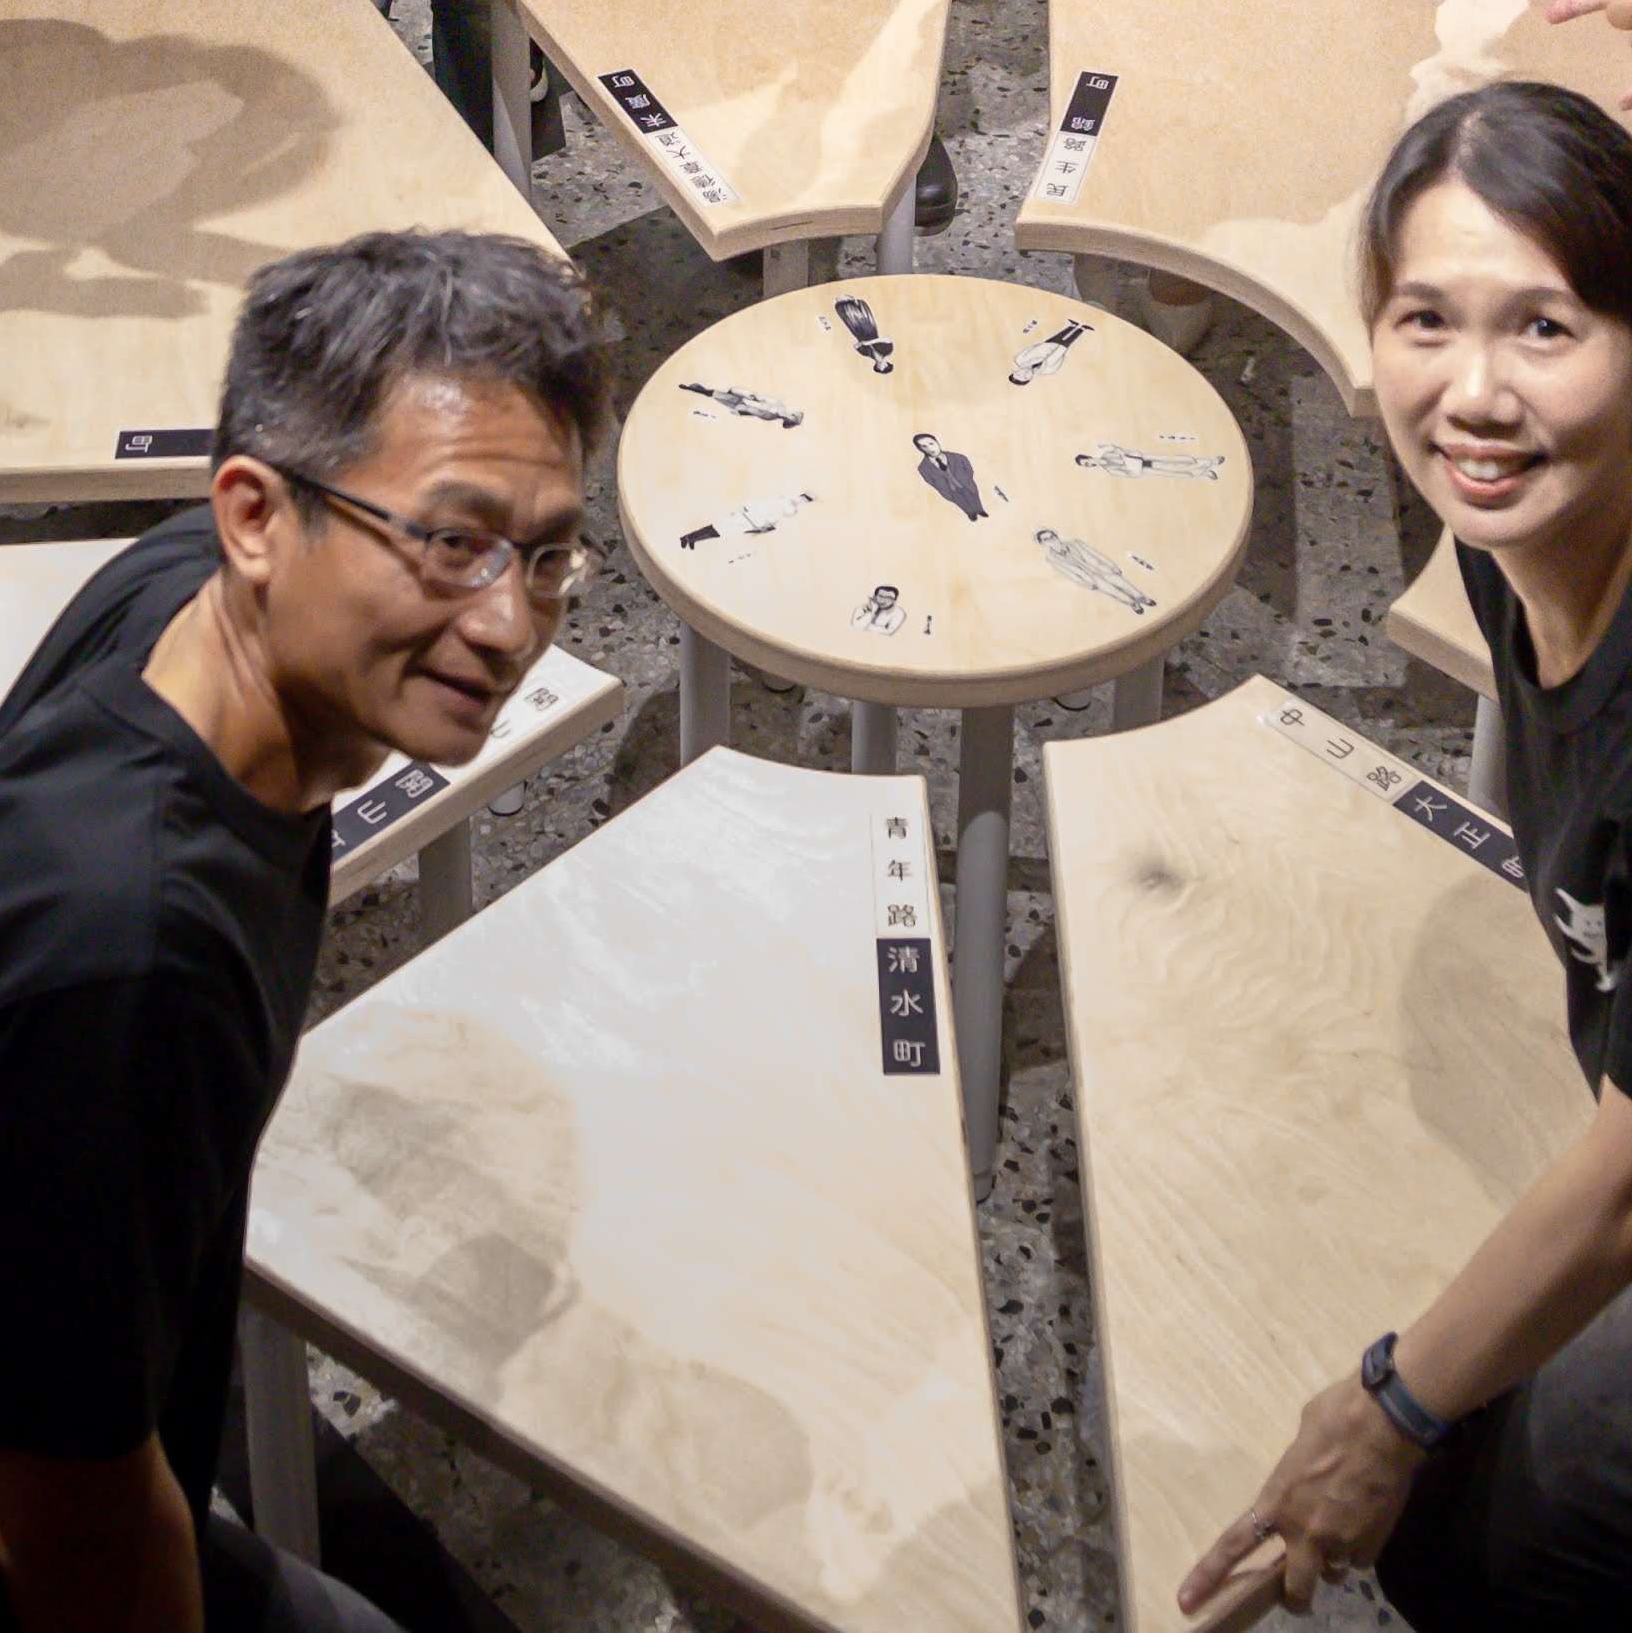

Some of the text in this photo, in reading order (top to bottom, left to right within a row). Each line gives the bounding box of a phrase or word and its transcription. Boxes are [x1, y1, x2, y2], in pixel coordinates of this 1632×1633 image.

[611, 74, 667, 128] 末廣町
[654, 131, 728, 204] 湯德章大道
[1046, 137, 1087, 197] 民生路
[124, 434, 154, 454] 町
[1279, 707, 1403, 792] 中山路
[885, 816, 918, 928] 青年路
[886, 945, 926, 1068] 清水町
